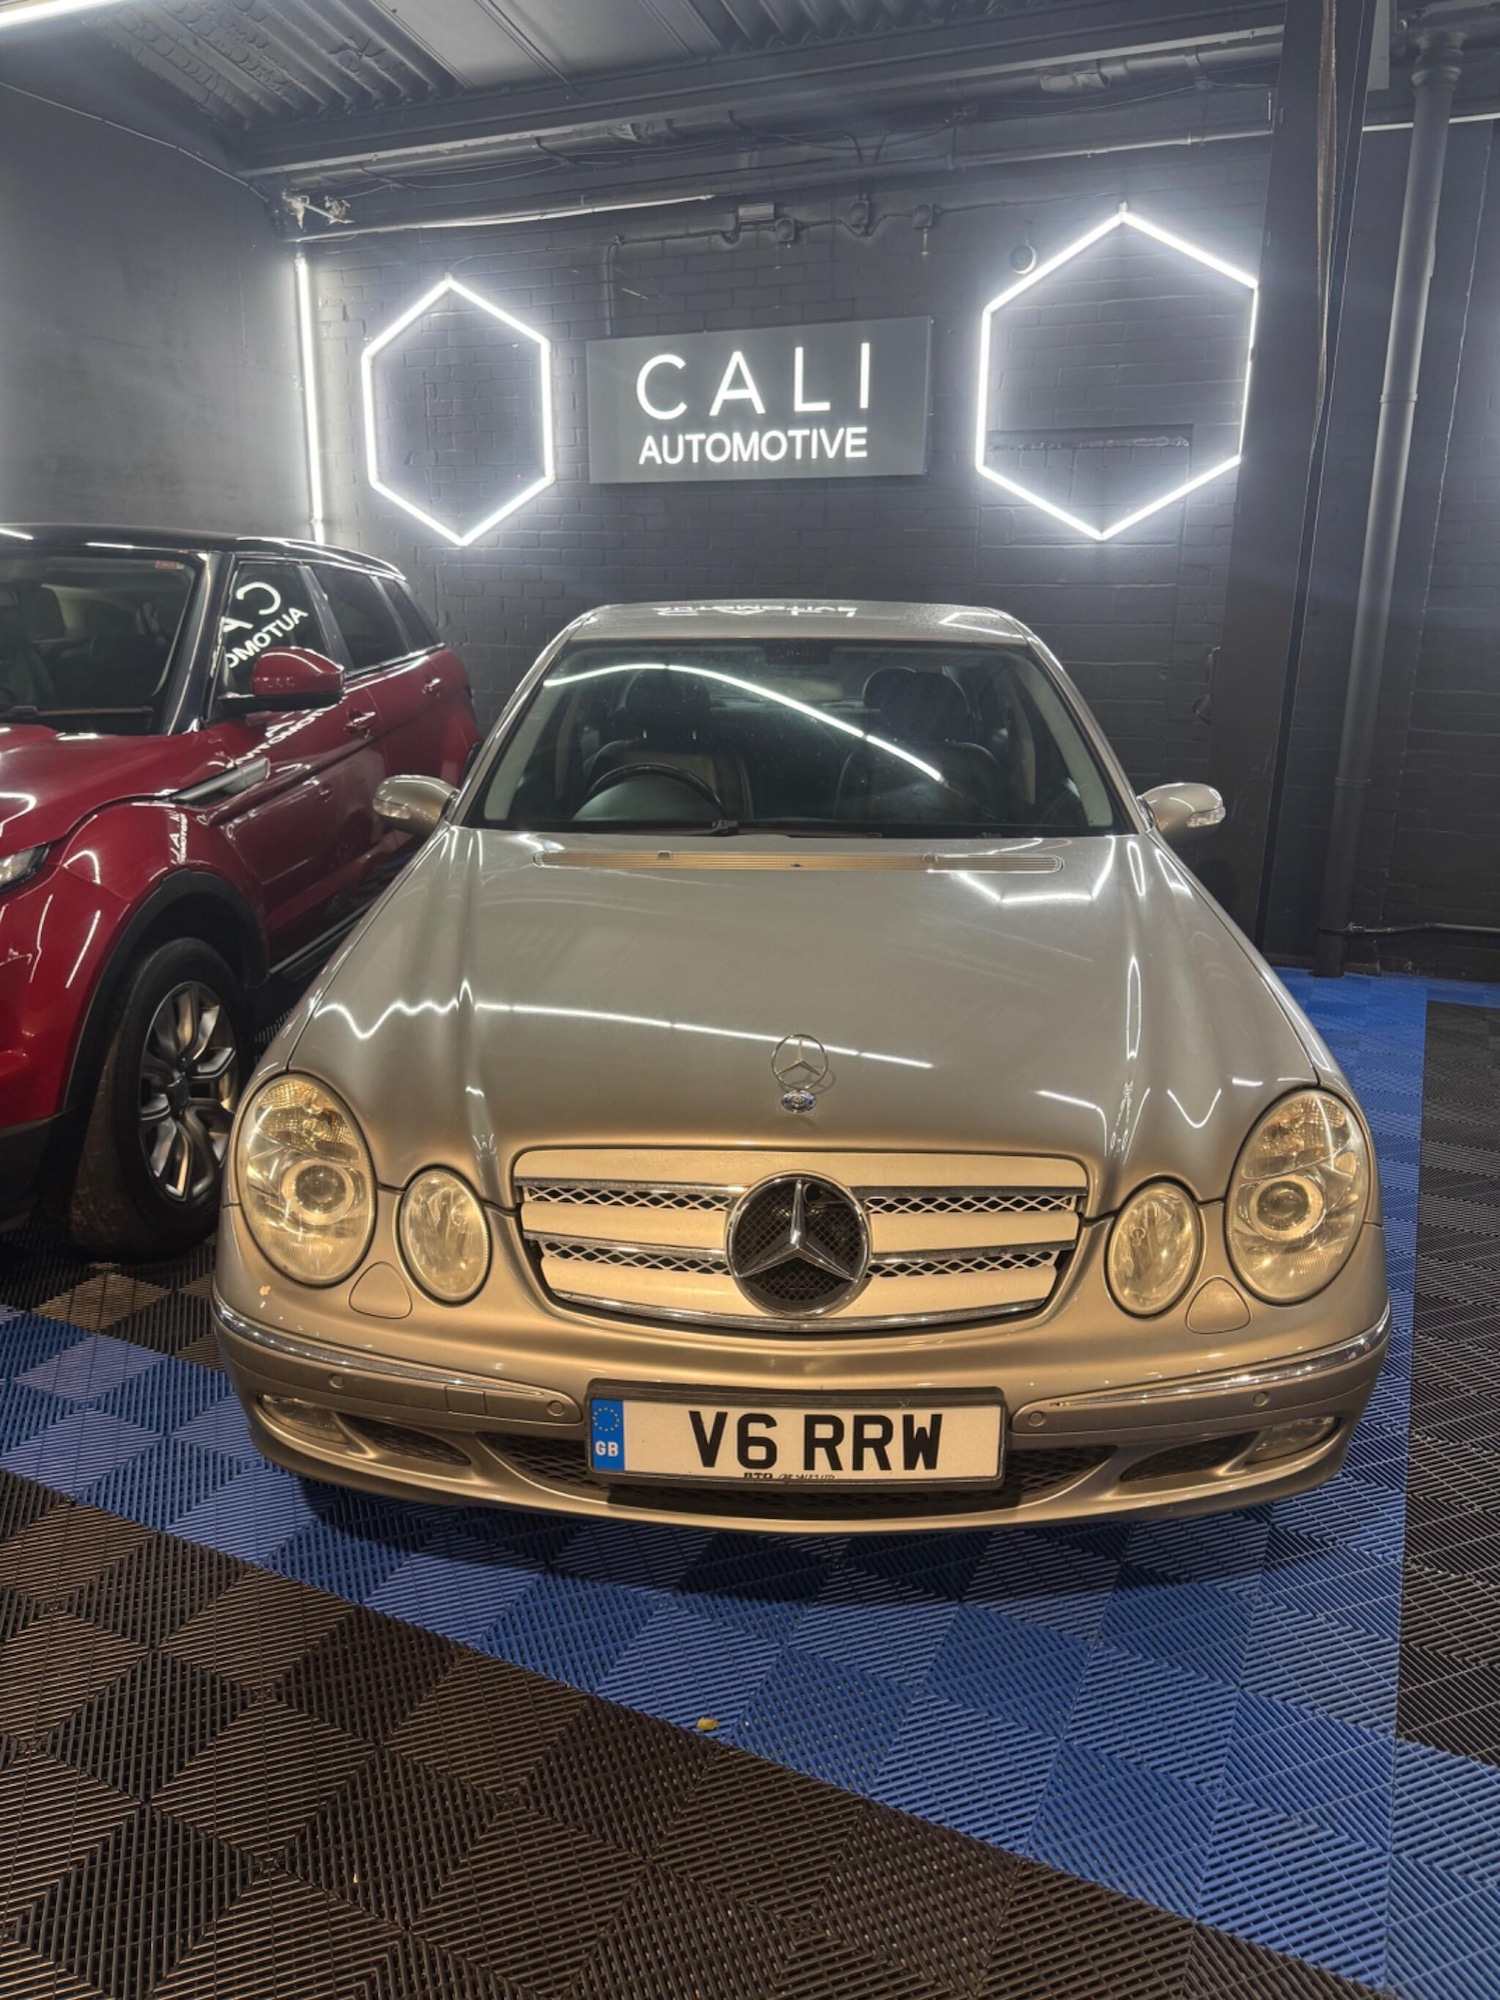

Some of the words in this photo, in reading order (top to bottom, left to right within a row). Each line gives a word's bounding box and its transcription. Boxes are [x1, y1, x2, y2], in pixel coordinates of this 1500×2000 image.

[636, 342, 871, 420] CALI
[638, 427, 868, 465] AUTOMOTIVE
[595, 1440, 619, 1457] GB
[688, 1411, 777, 1470] V6
[803, 1414, 943, 1471] RRW
